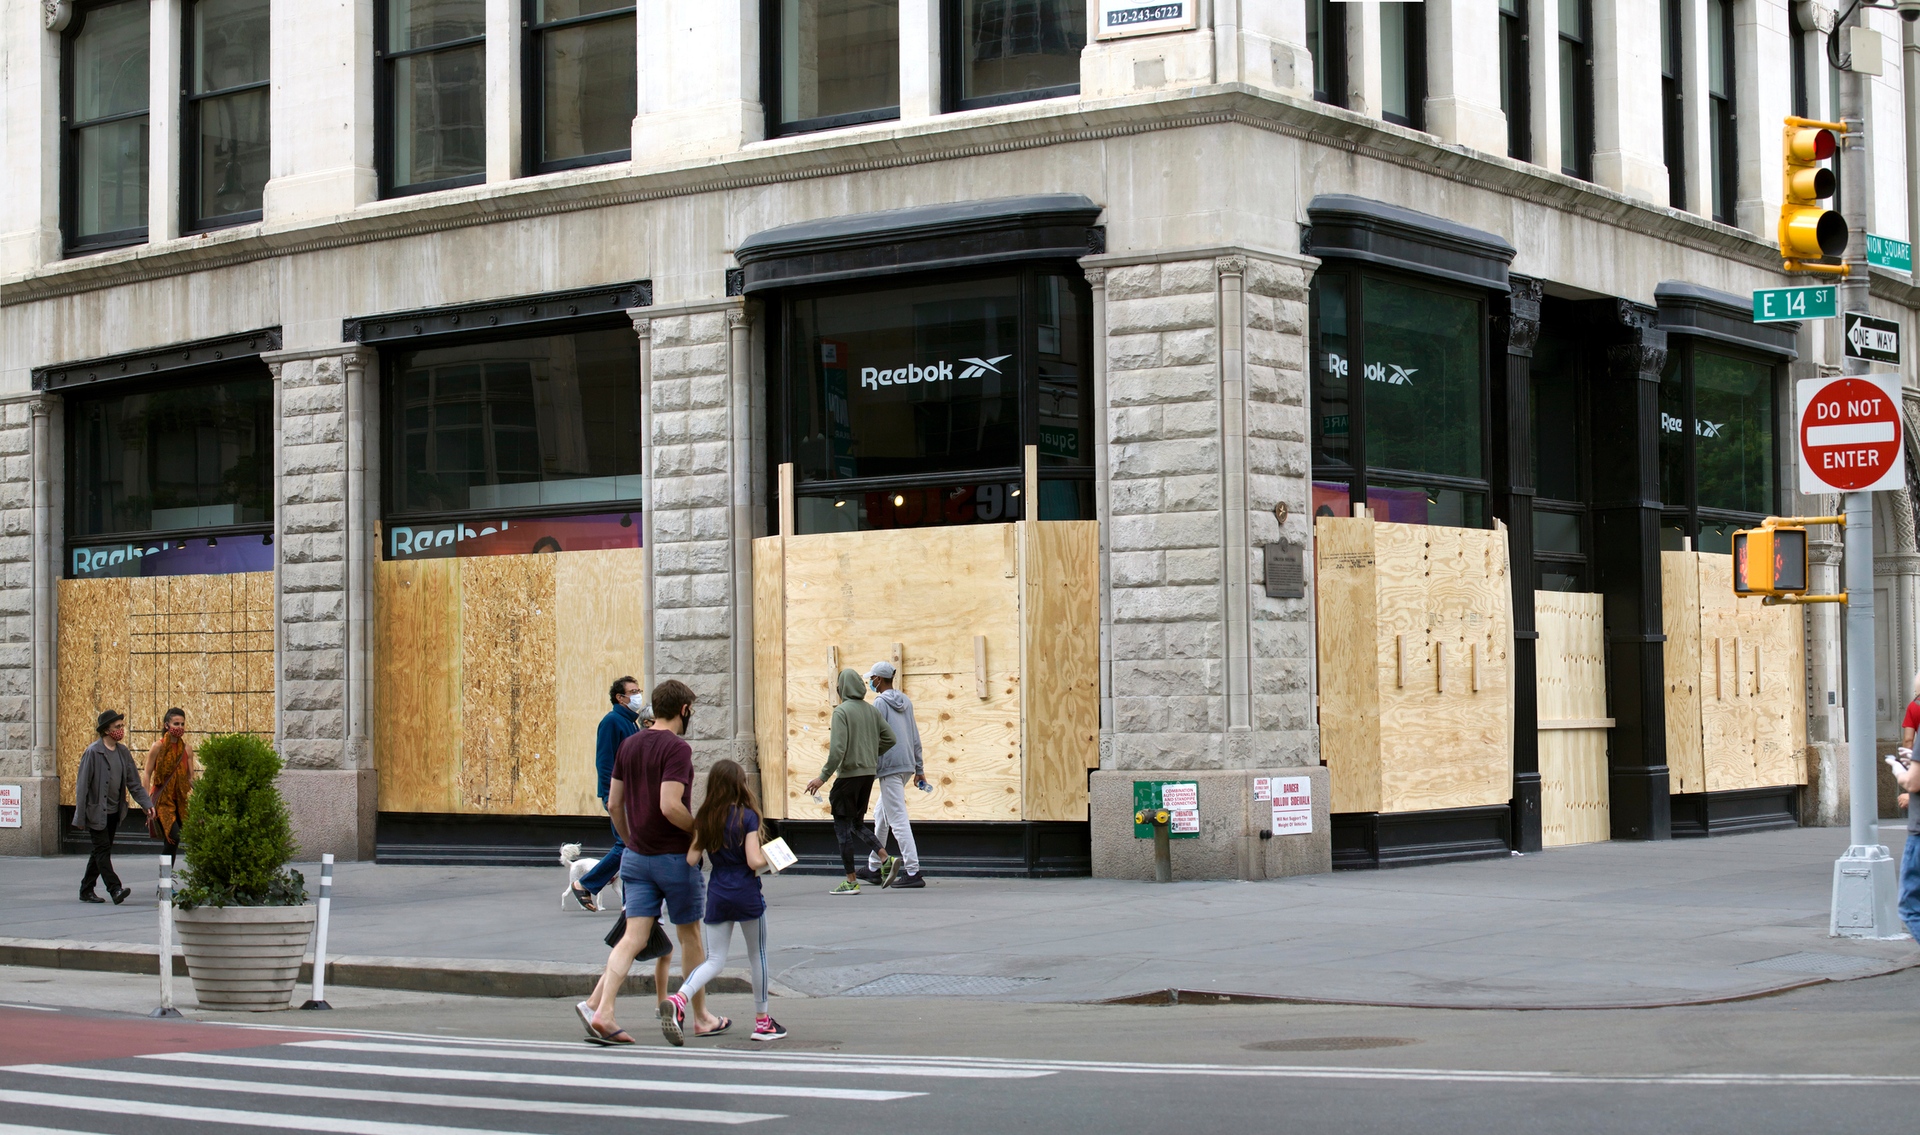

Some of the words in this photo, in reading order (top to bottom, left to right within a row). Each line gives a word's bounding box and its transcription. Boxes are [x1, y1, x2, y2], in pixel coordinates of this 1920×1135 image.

[1111, 5, 1179, 24] 212-243-6722
[1867, 236, 1882, 254] NION
[1884, 240, 1910, 261] SQUARE
[1763, 293, 1776, 317] E
[1785, 291, 1806, 316] 14
[1815, 290, 1828, 303] ST
[1853, 328, 1870, 347] ONE
[1876, 331, 1894, 351] WAY
[861, 360, 953, 391] Reebok
[1328, 353, 1386, 382] Reok
[1817, 401, 1841, 420] DO
[1848, 399, 1882, 418] NOT
[1661, 412, 1702, 435] Reek
[1823, 449, 1880, 470] ENTER
[1284, 784, 1299, 793] DANGER
[1290, 796, 1310, 806] SIDEWALK
